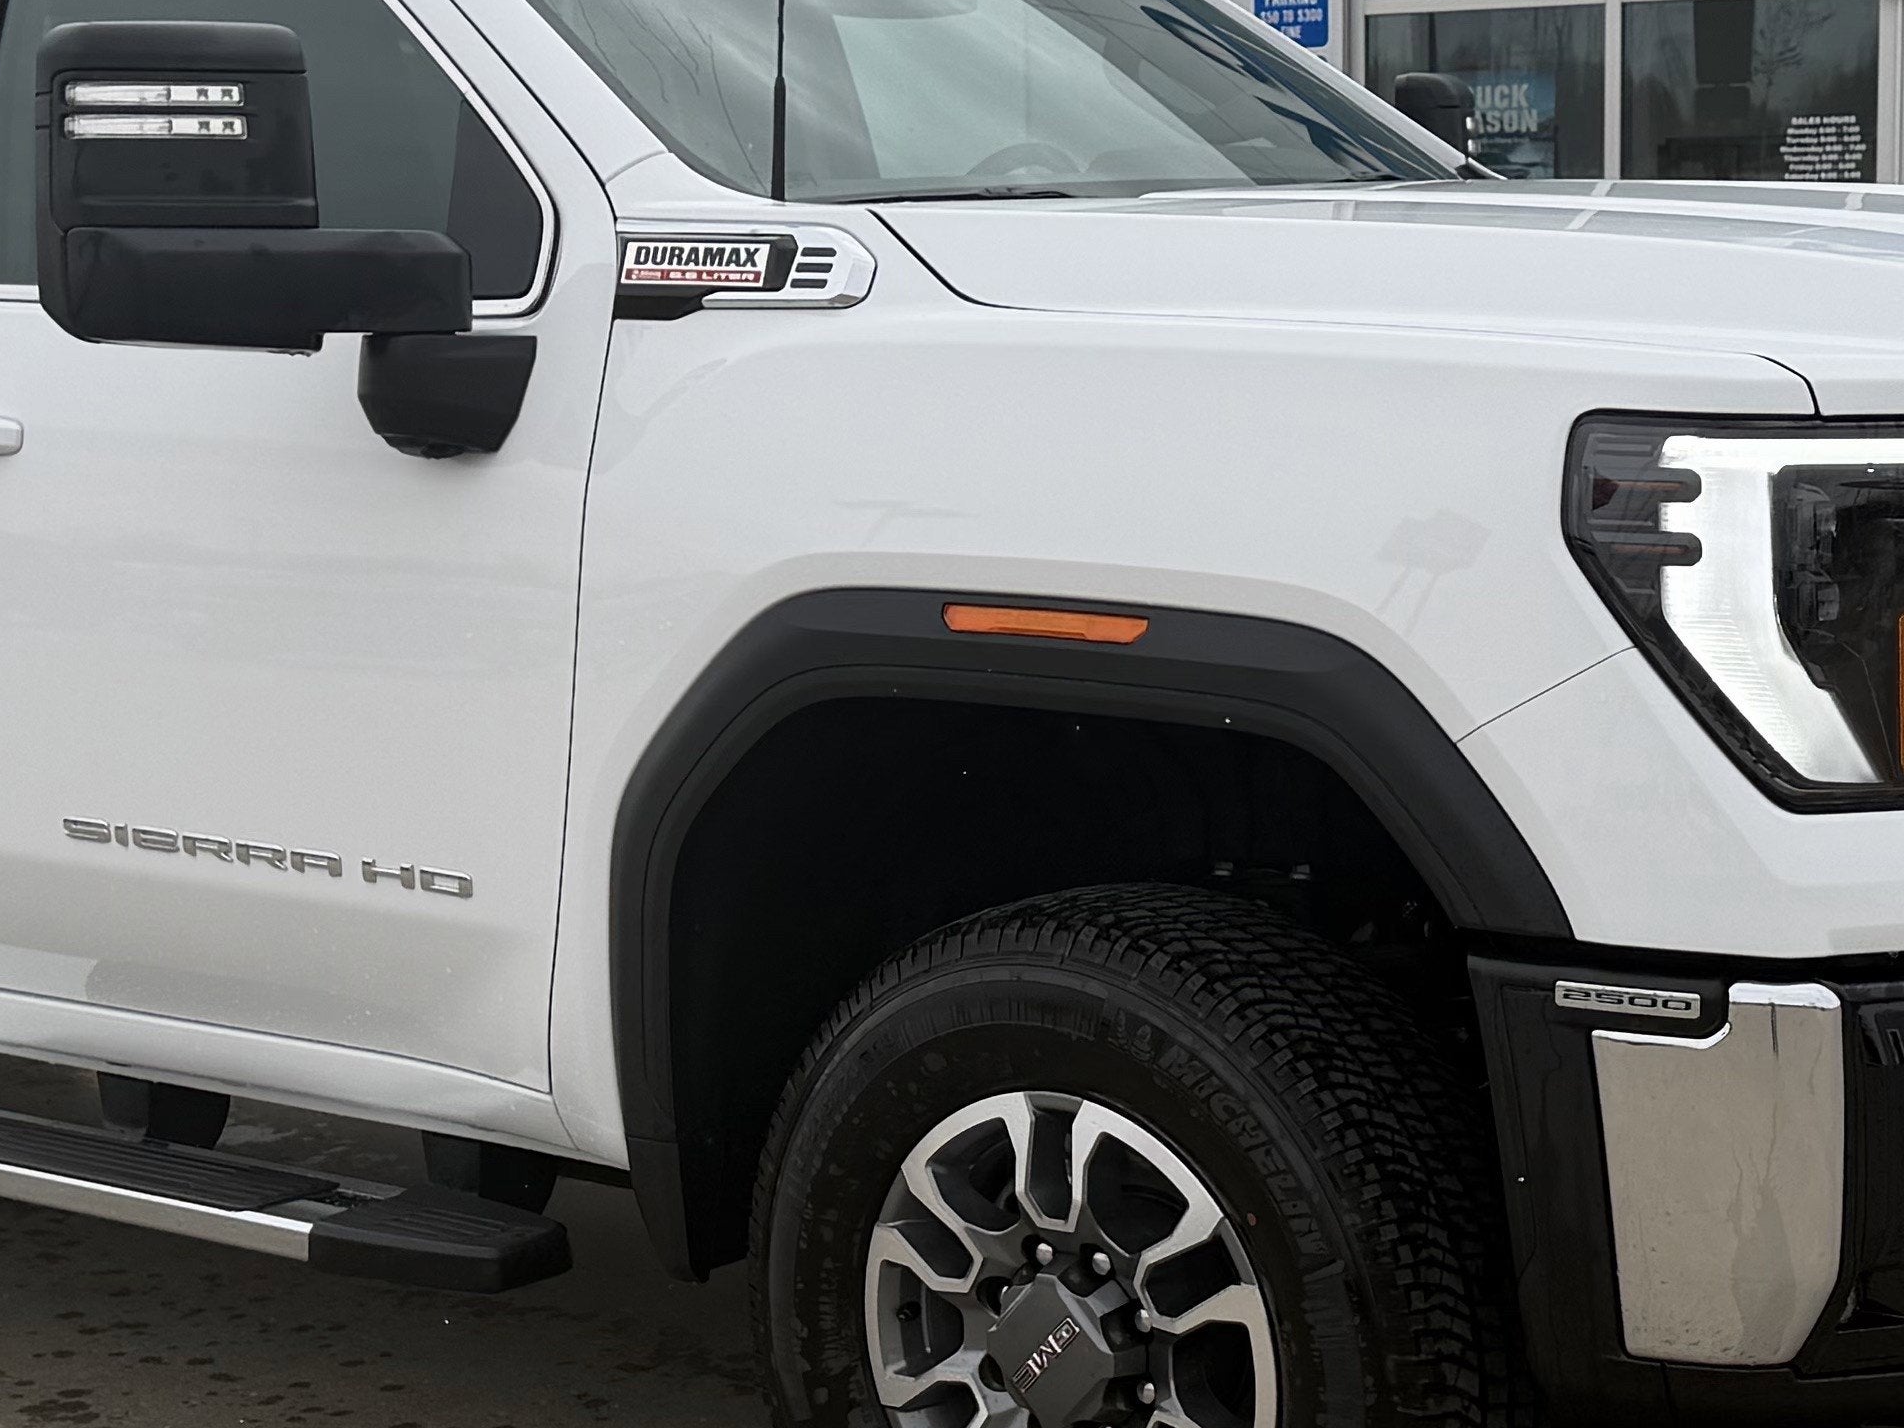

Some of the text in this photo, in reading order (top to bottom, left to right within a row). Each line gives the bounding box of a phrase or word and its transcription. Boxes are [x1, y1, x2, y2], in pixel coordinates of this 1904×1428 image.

[1283, 9, 1294, 22] TO
[1297, 8, 1323, 22] $300
[1475, 83, 1529, 109] UCK
[633, 245, 760, 268] DURAMAX
[62, 815, 474, 899] SIERRA HD
[1562, 987, 1693, 1012] 2500
[1157, 1044, 1330, 1256] MICHELIN
